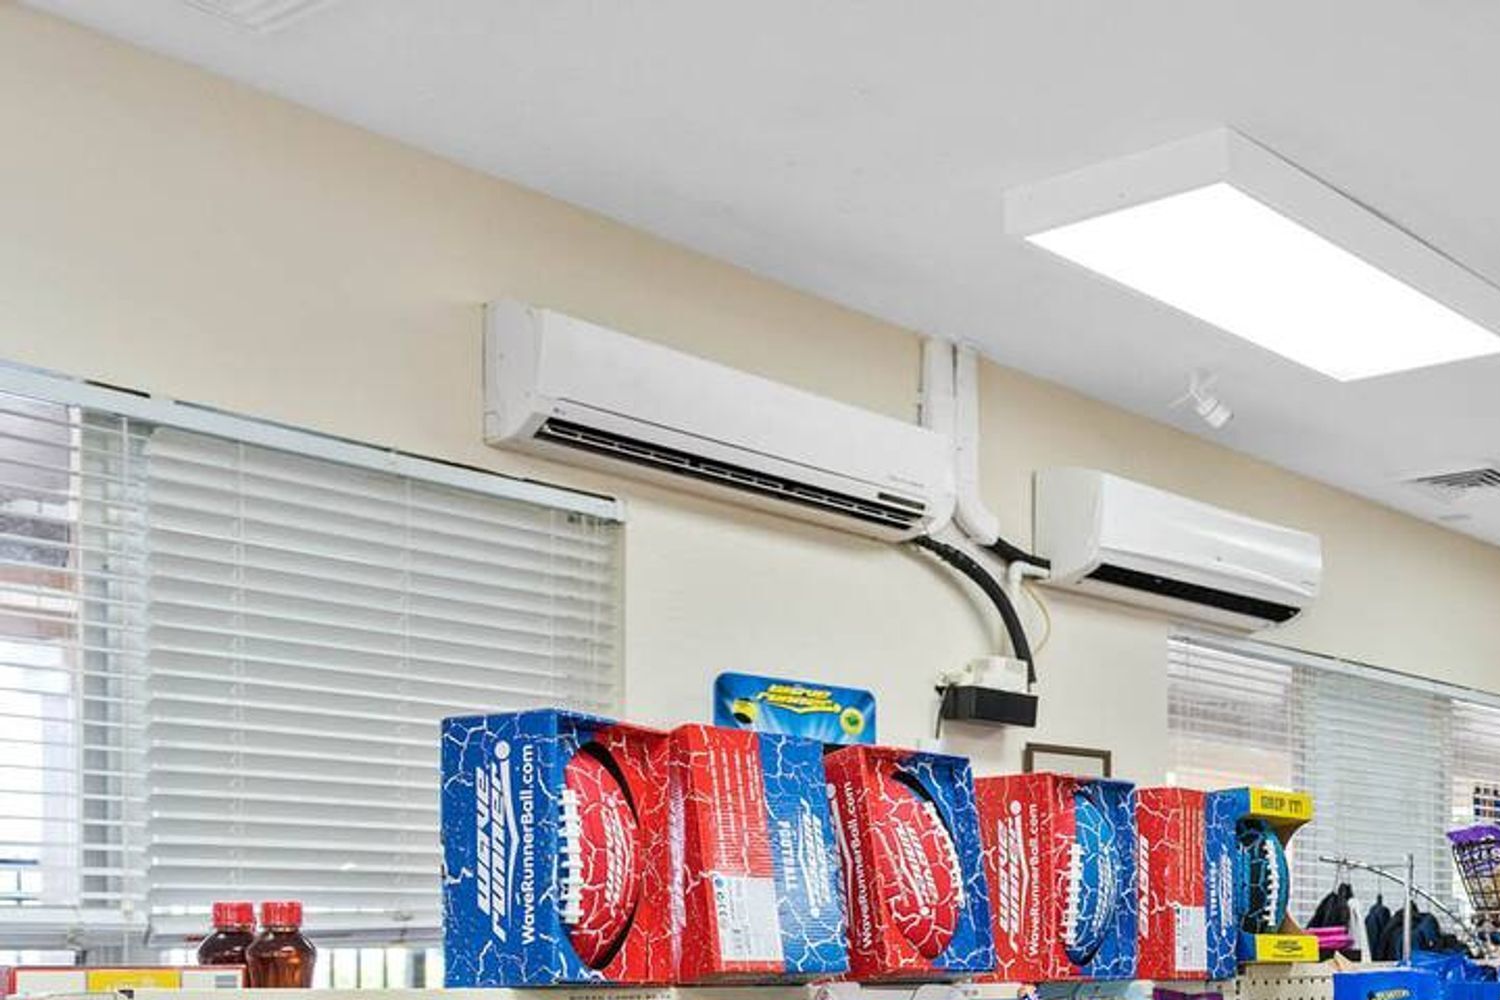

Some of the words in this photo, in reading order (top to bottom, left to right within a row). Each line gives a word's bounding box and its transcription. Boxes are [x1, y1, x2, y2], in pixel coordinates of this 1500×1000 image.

[520, 745, 534, 945] WaveRunnerBall.com
[844, 781, 872, 949] WaveRunnerBall.com
[1029, 804, 1040, 956] WaveRunnerBall.com
